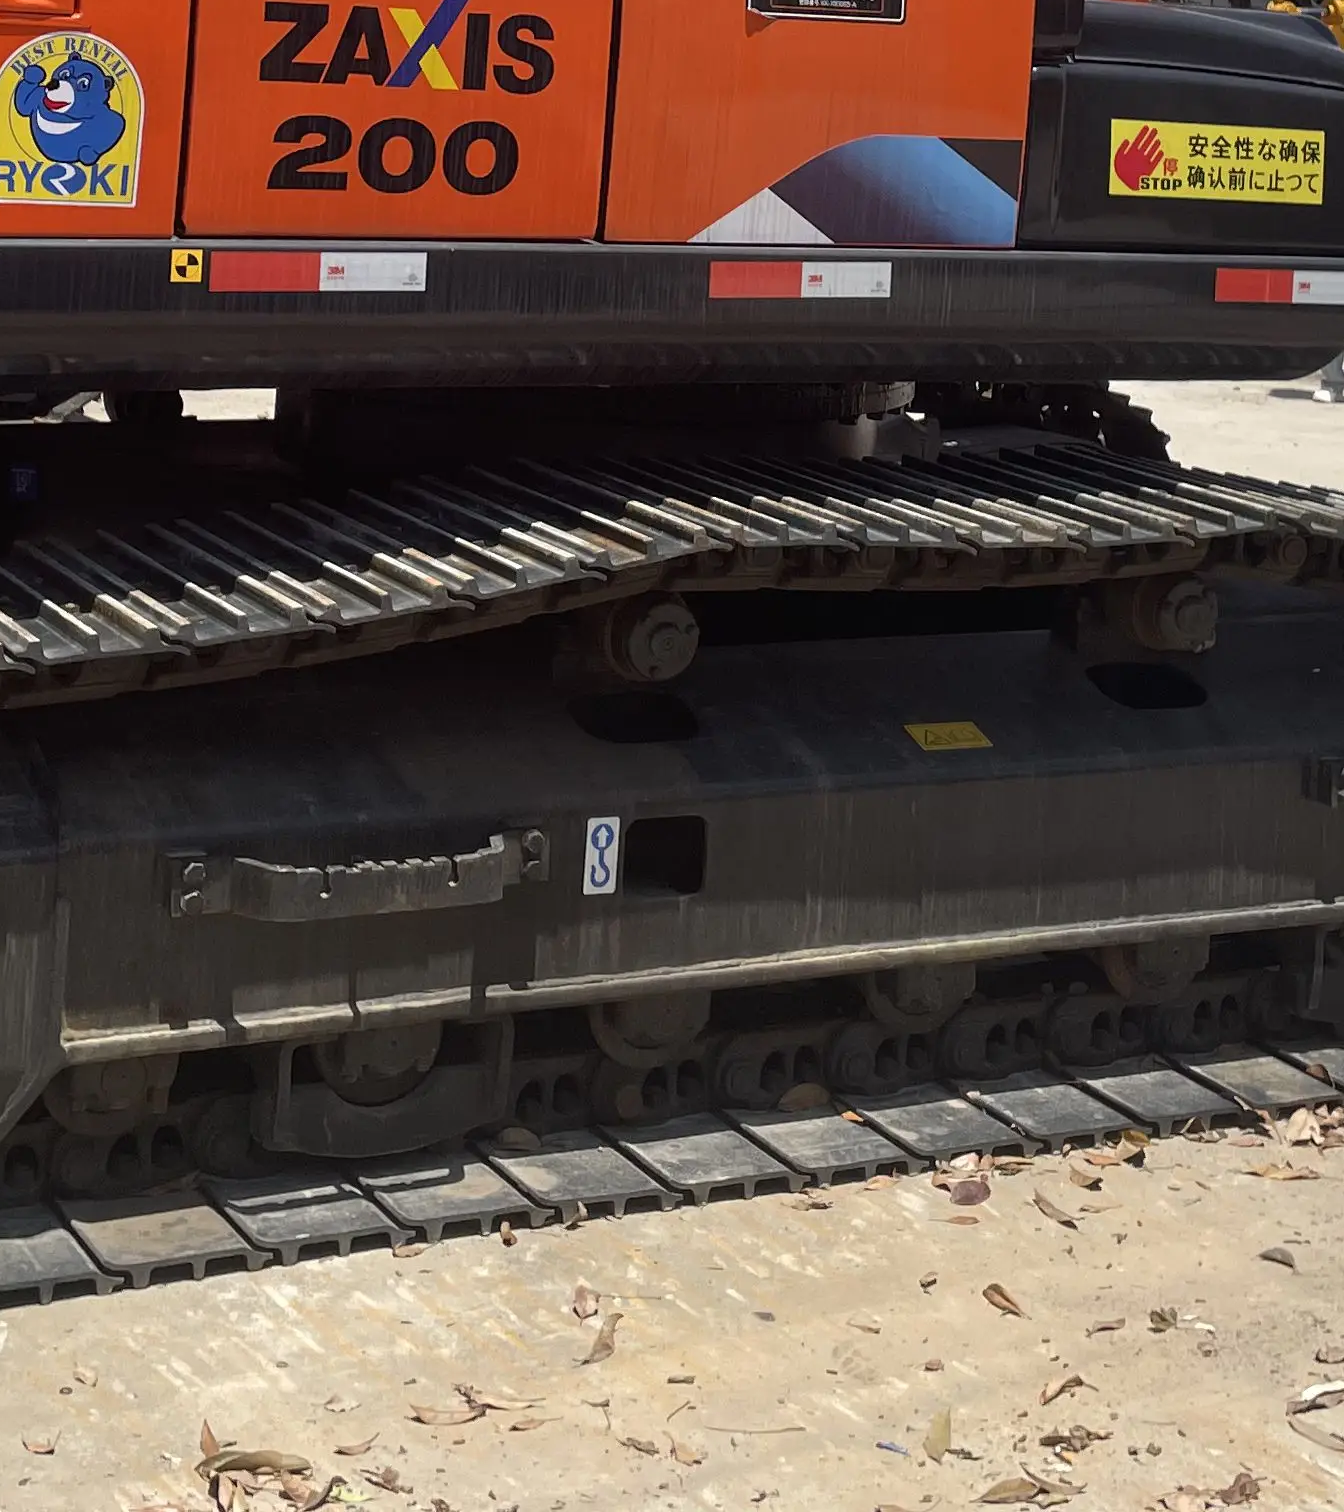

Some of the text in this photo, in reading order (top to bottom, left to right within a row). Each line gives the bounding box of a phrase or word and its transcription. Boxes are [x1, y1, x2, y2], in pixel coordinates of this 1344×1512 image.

[10, 37, 128, 81] BEST RENTAL
[266, 115, 519, 196] 200
[1140, 176, 1183, 192] STOP
